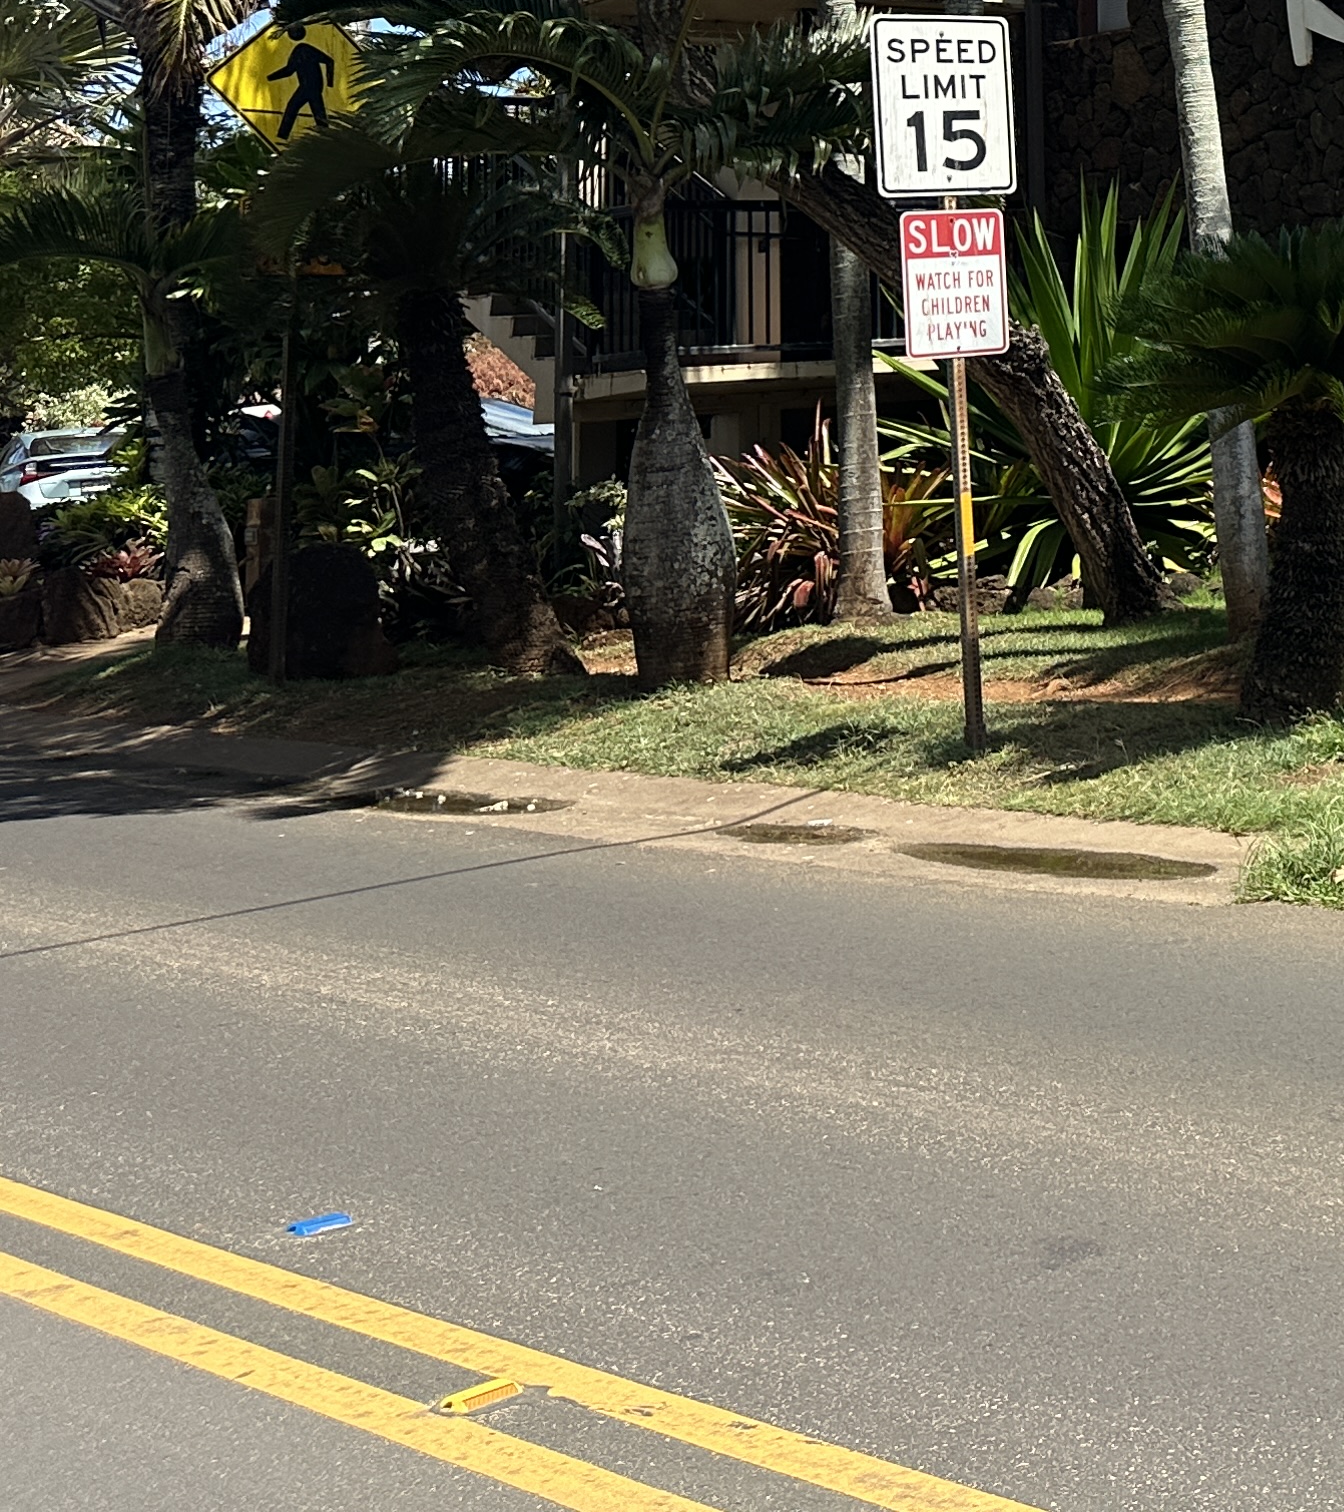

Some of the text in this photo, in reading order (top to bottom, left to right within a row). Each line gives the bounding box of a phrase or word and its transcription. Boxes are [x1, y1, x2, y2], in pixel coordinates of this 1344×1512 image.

[887, 38, 996, 64] SPEED
[901, 74, 985, 100] LIMIT
[906, 110, 987, 172] 15
[908, 217, 995, 254] SLOW
[915, 269, 994, 291] WATCH FOR
[921, 294, 990, 316] CHILDREN
